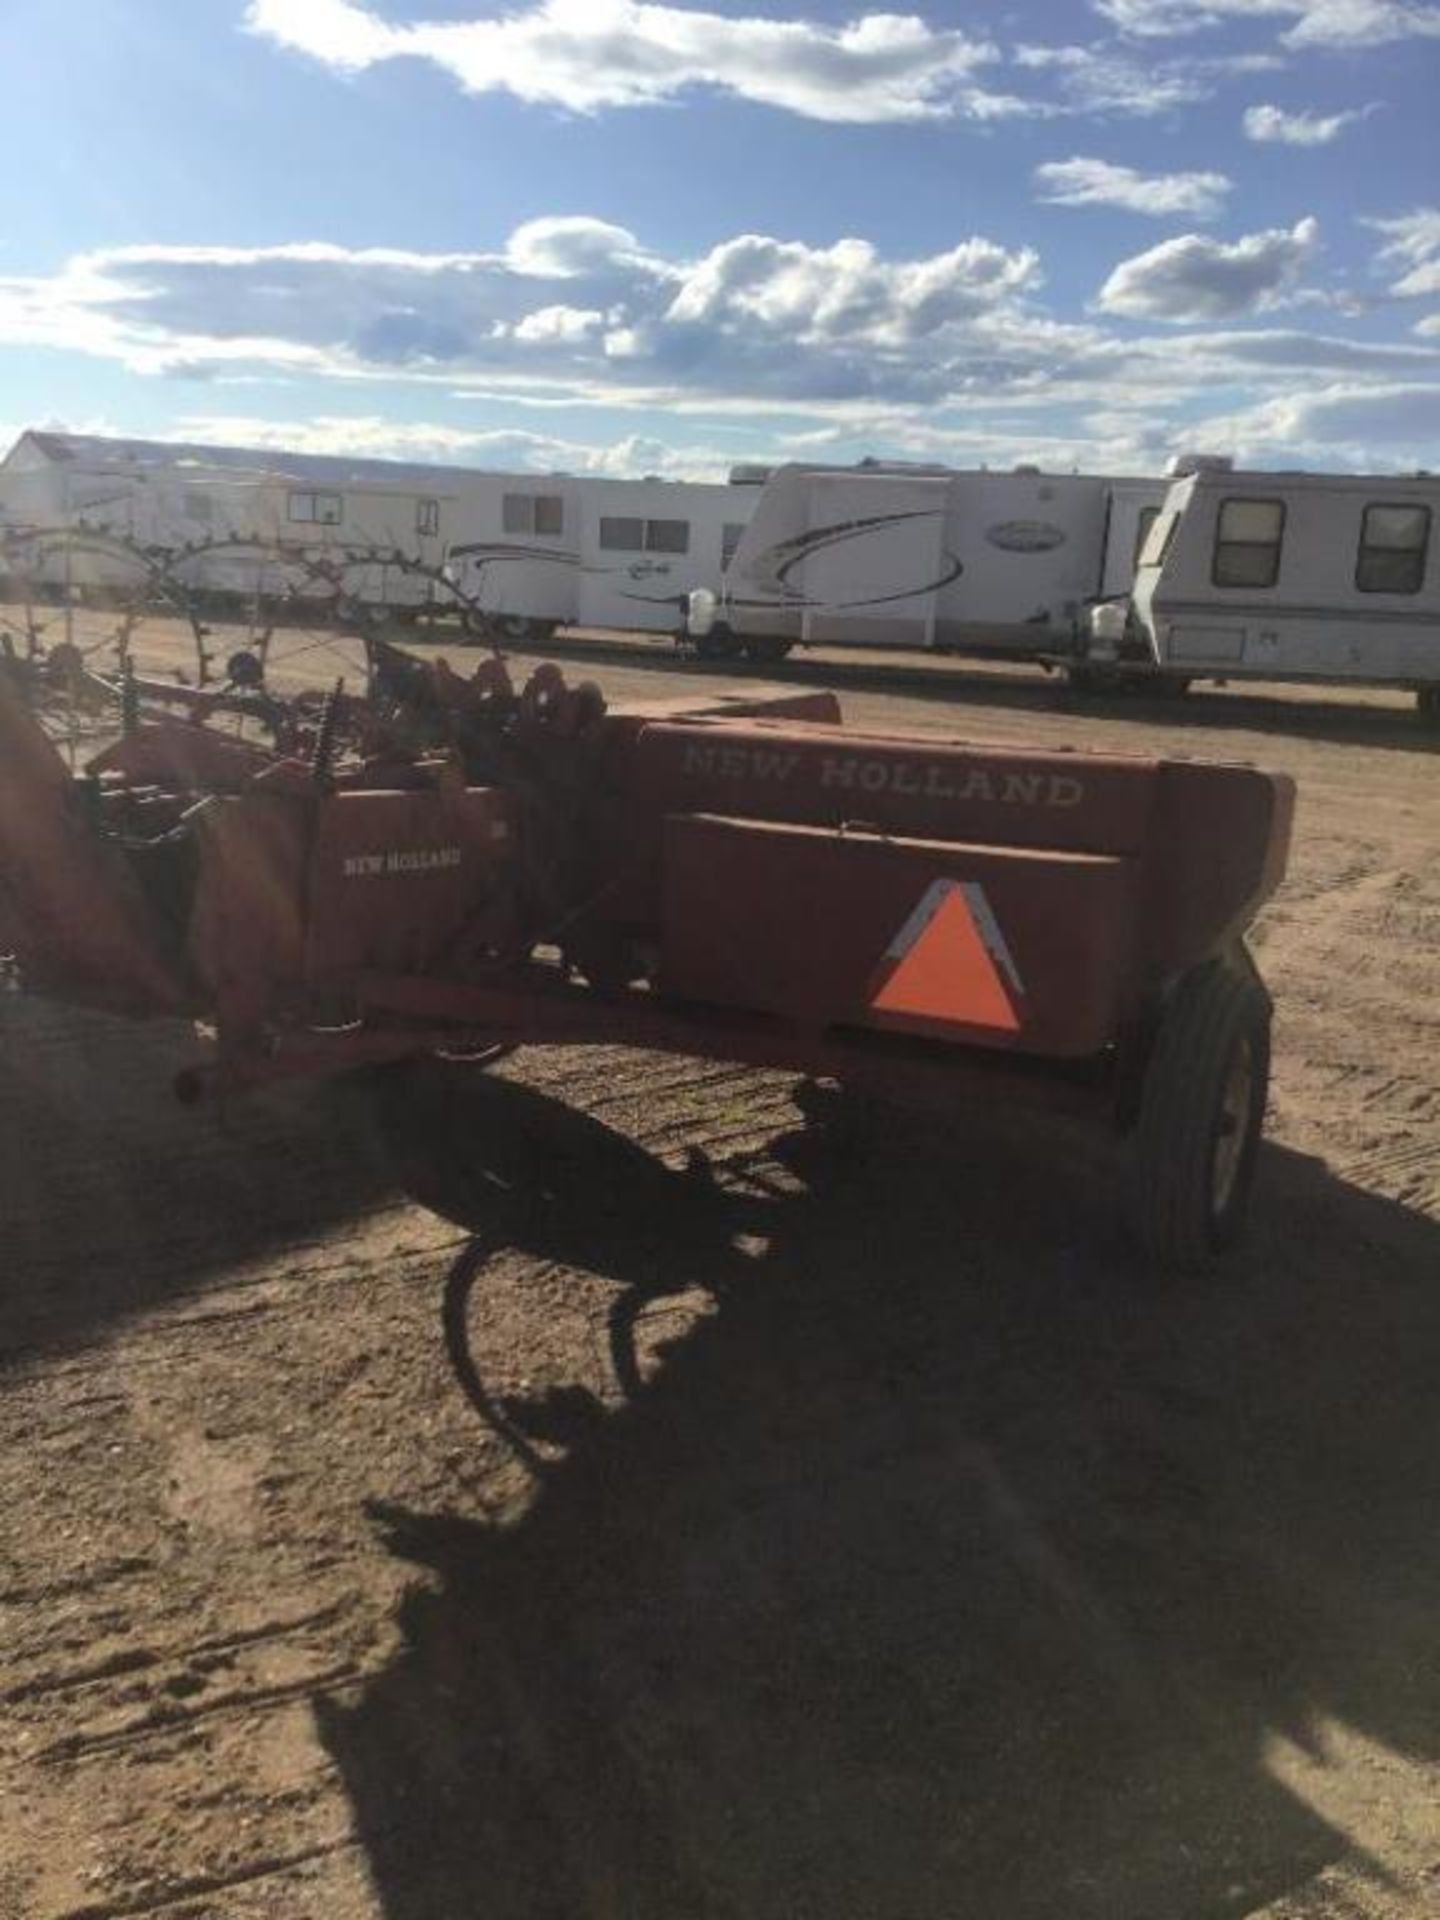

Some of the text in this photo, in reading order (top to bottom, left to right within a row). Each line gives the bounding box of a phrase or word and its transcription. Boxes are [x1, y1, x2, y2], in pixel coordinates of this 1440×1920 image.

[681, 745, 1085, 807] NEW HOLLAND
[344, 847, 461, 876] NEW HOLLAND
